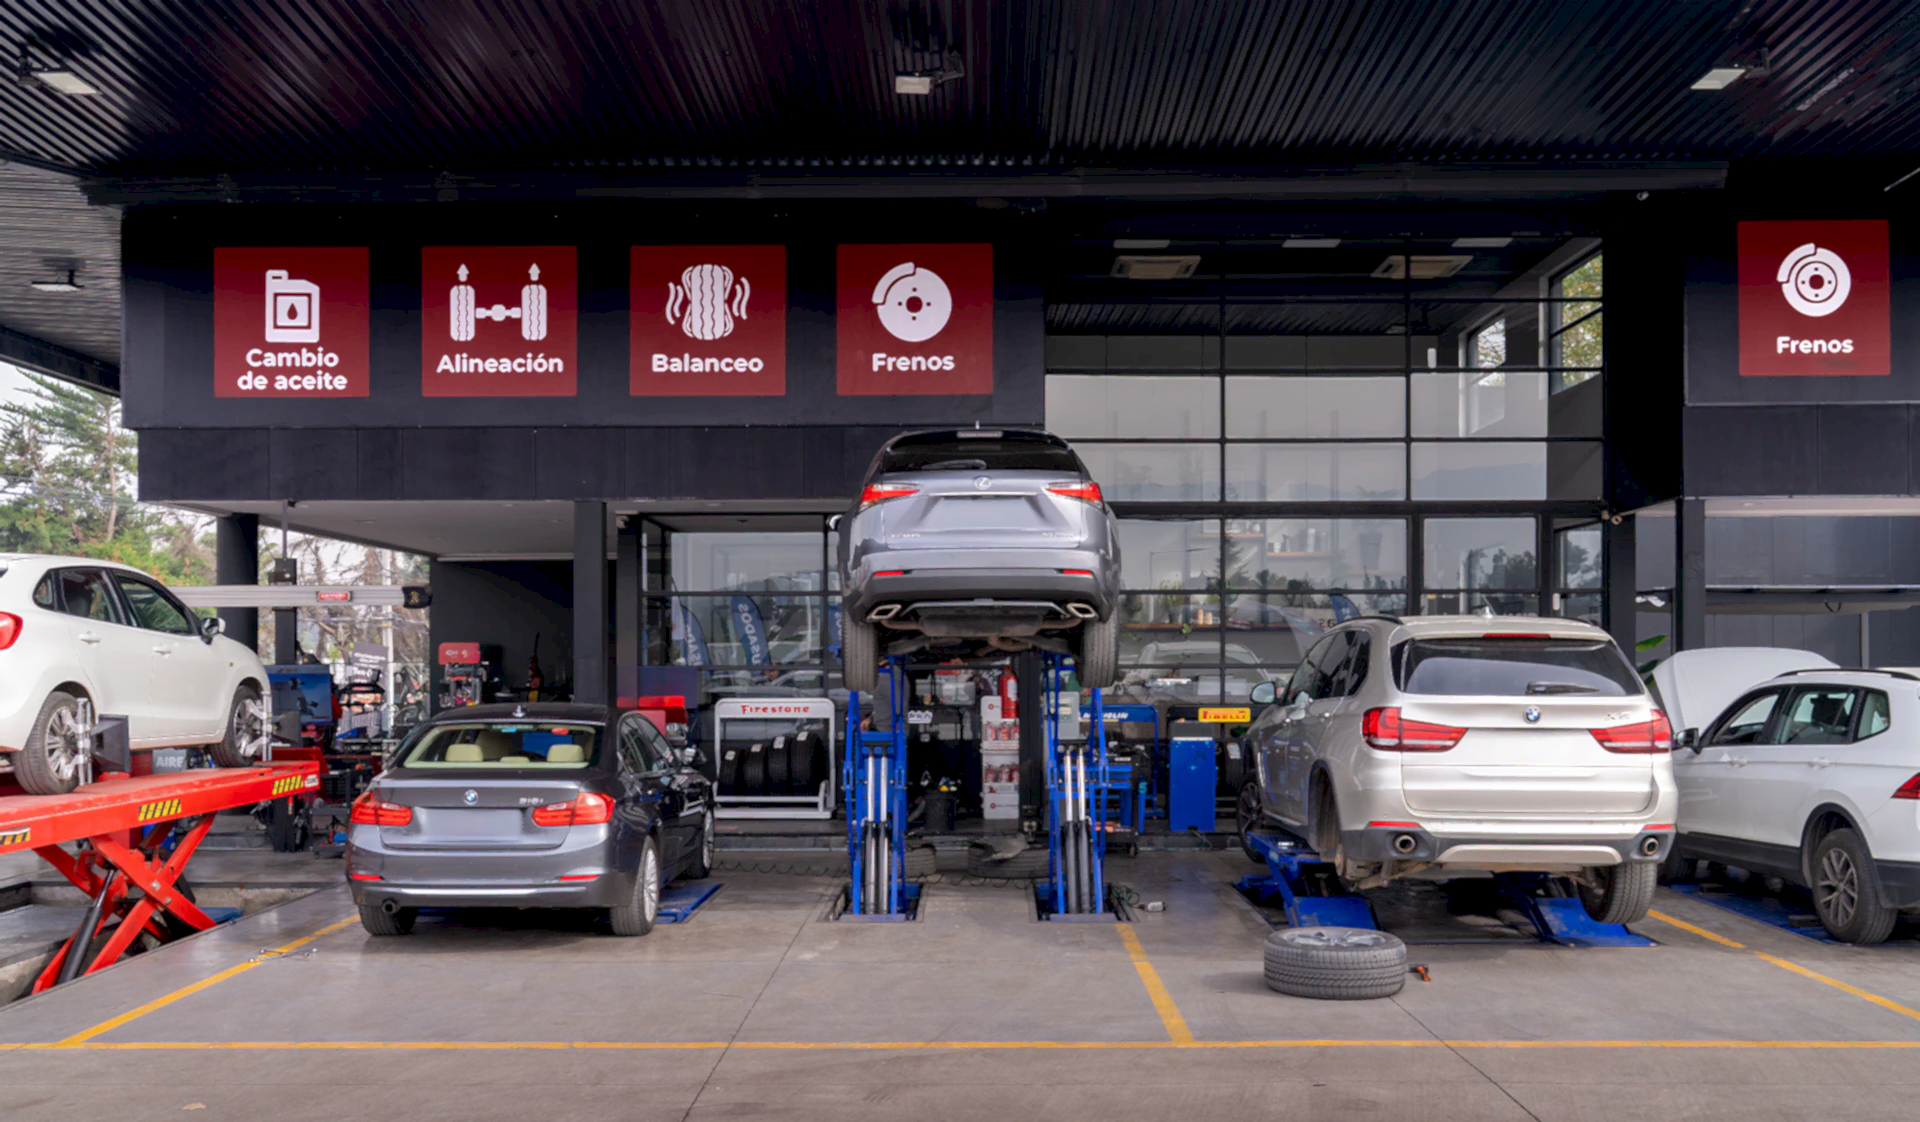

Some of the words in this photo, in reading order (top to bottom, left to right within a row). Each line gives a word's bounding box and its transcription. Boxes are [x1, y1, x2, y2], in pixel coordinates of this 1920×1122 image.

[1776, 336, 1854, 354] Frenos
[245, 346, 339, 367] Cambio
[436, 353, 564, 373] Alineación
[652, 353, 764, 373] Balanceo
[872, 353, 955, 372] Frenos
[237, 371, 268, 390] de
[274, 371, 348, 390] aceite
[741, 705, 810, 715] Firestone
[156, 756, 184, 768] AIRE
